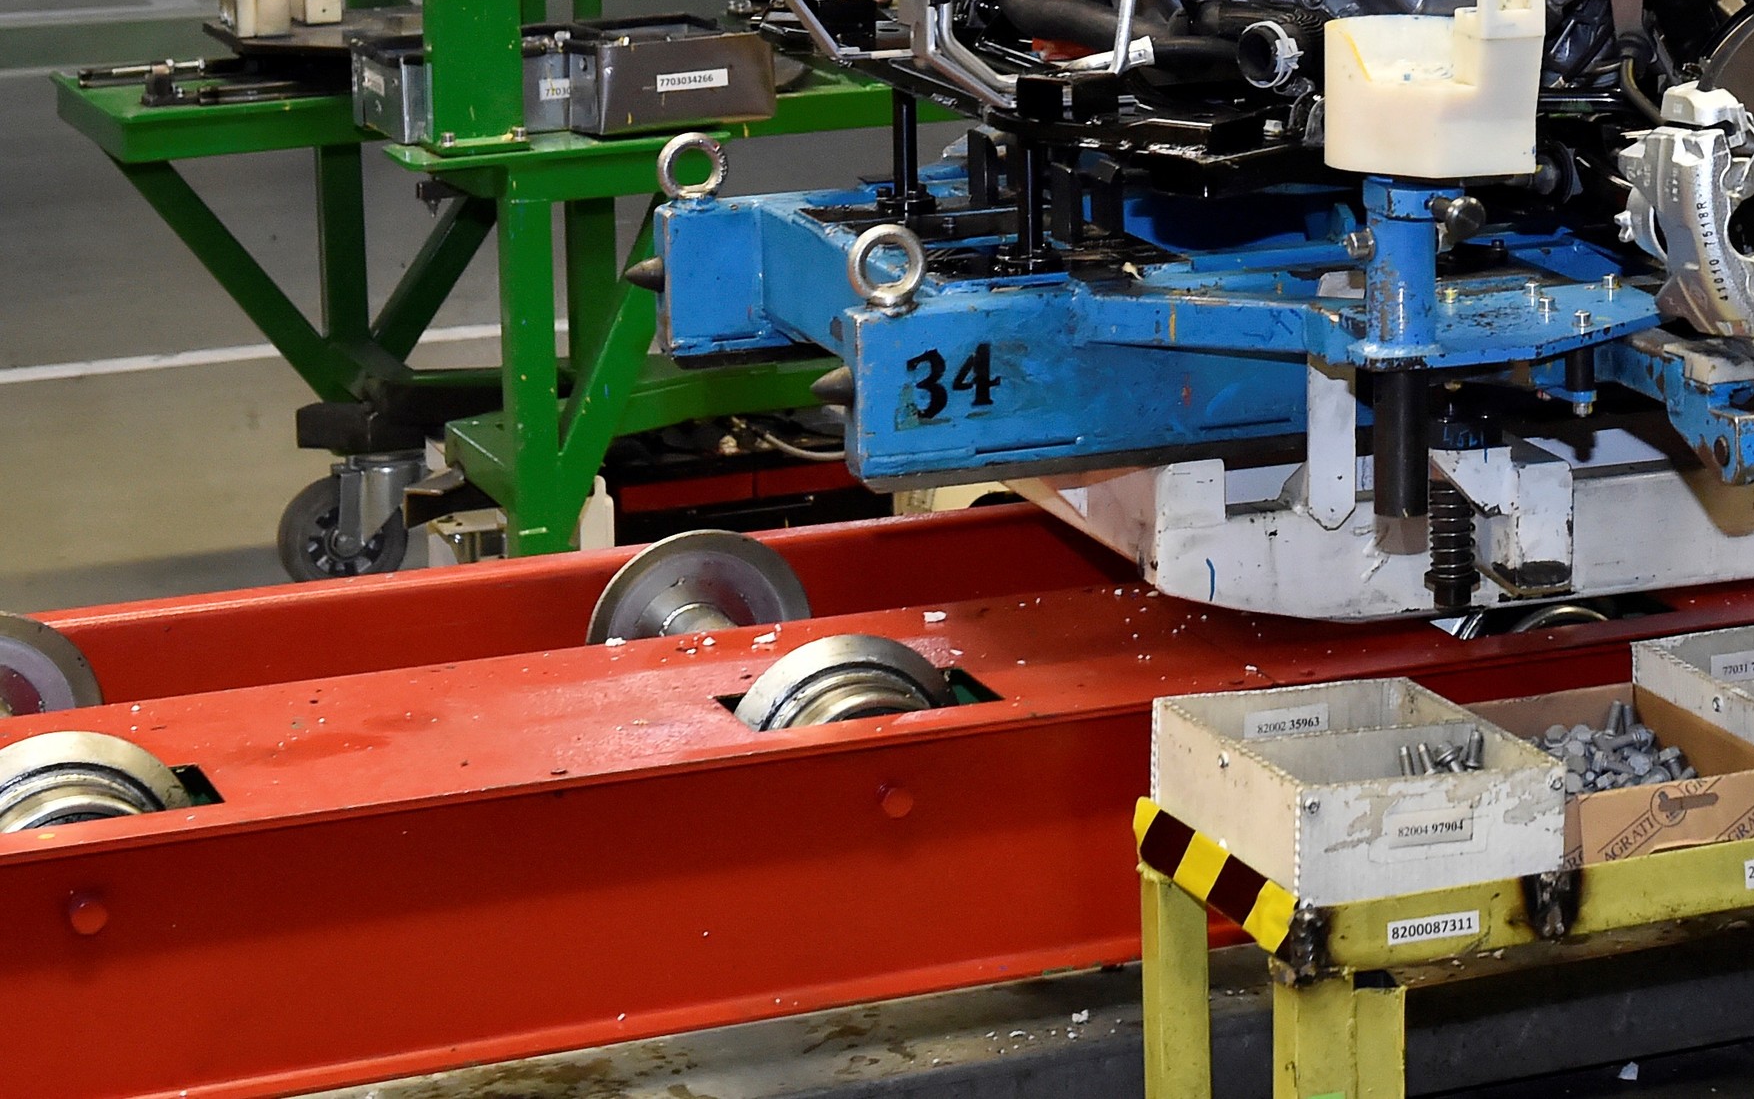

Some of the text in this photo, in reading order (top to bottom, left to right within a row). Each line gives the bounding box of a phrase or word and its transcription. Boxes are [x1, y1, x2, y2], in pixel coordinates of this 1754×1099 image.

[660, 74, 714, 87] 7703034266
[1696, 202, 1716, 247] 7518R
[906, 342, 1001, 419] 34
[1722, 664, 1748, 676] 77031
[1257, 716, 1320, 734] 82002 35963
[1398, 819, 1463, 837] 82004 97904
[1391, 917, 1472, 939] 8200087311
